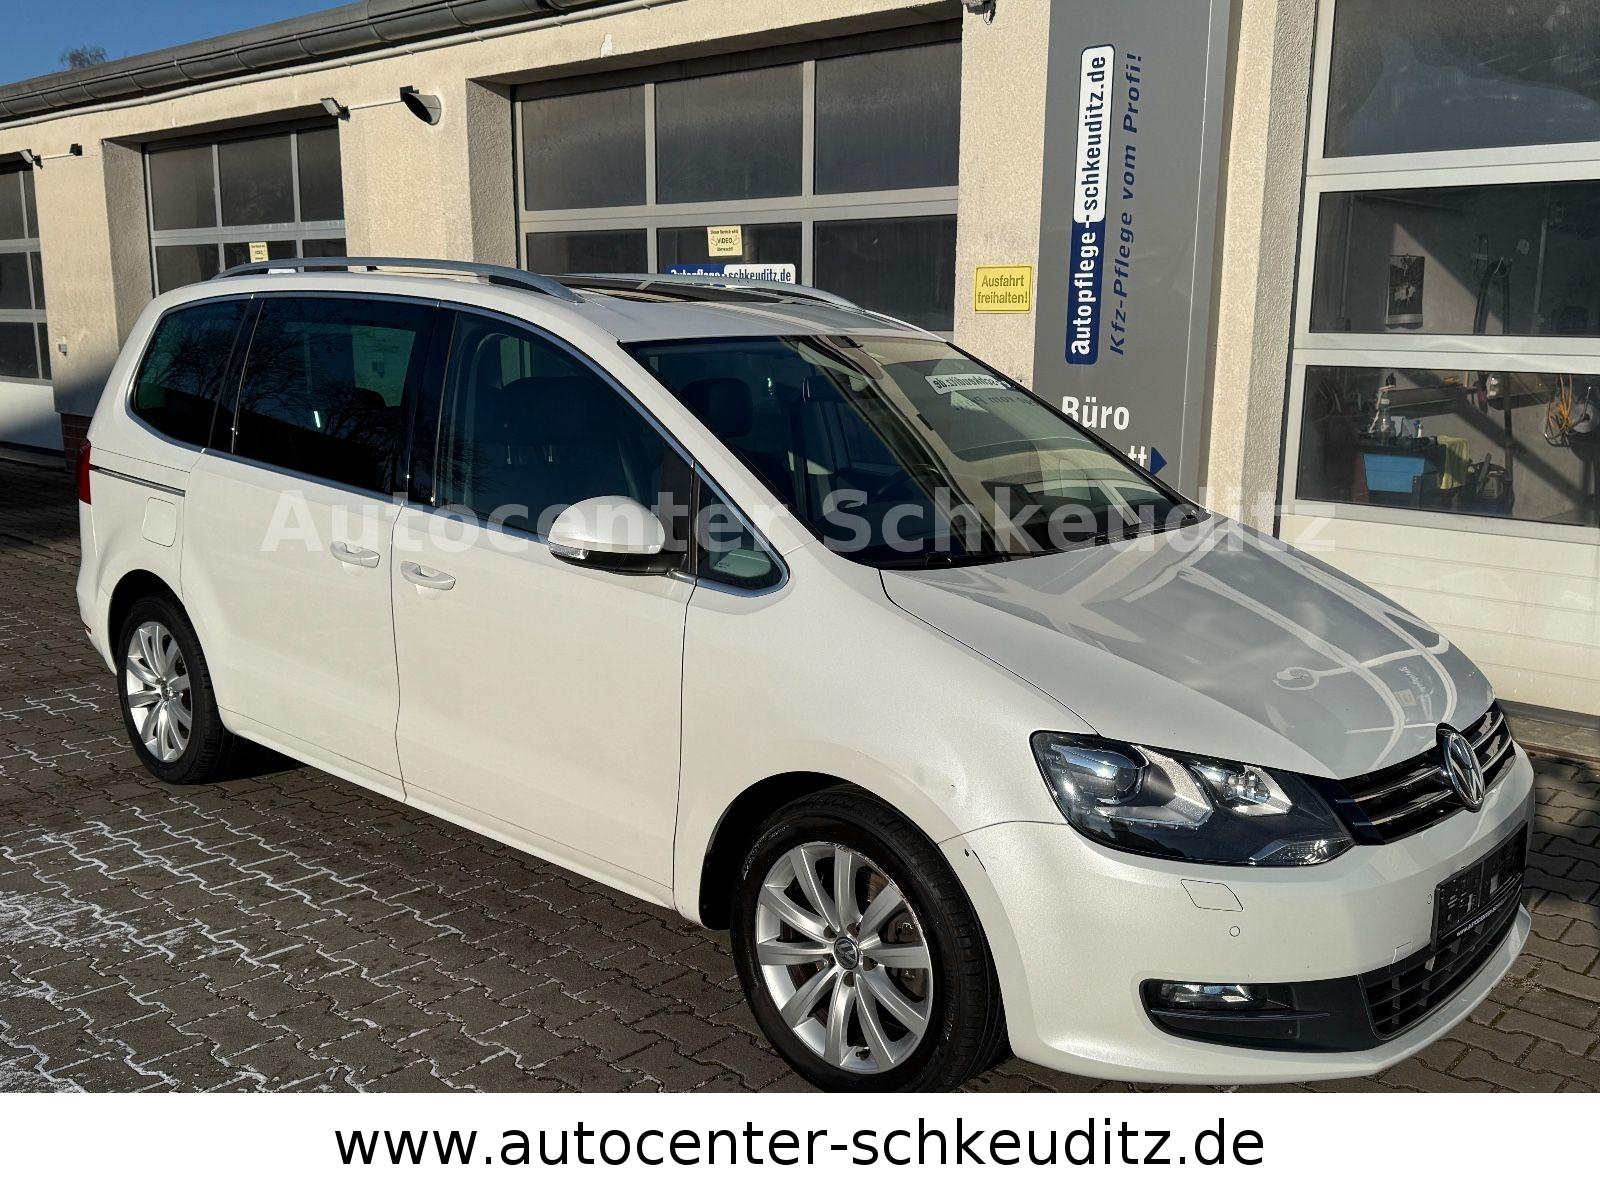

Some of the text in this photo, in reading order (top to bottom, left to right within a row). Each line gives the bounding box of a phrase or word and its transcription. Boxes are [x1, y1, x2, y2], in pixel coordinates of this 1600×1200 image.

[1071, 56, 1106, 355] autopflege-schkeuditz.de
[1109, 52, 1143, 356] Kfz-Pflege vom Profi!
[977, 291, 1028, 304] freihalten!
[981, 274, 1025, 287] Ausfahrt
[1062, 395, 1130, 431] Büro
